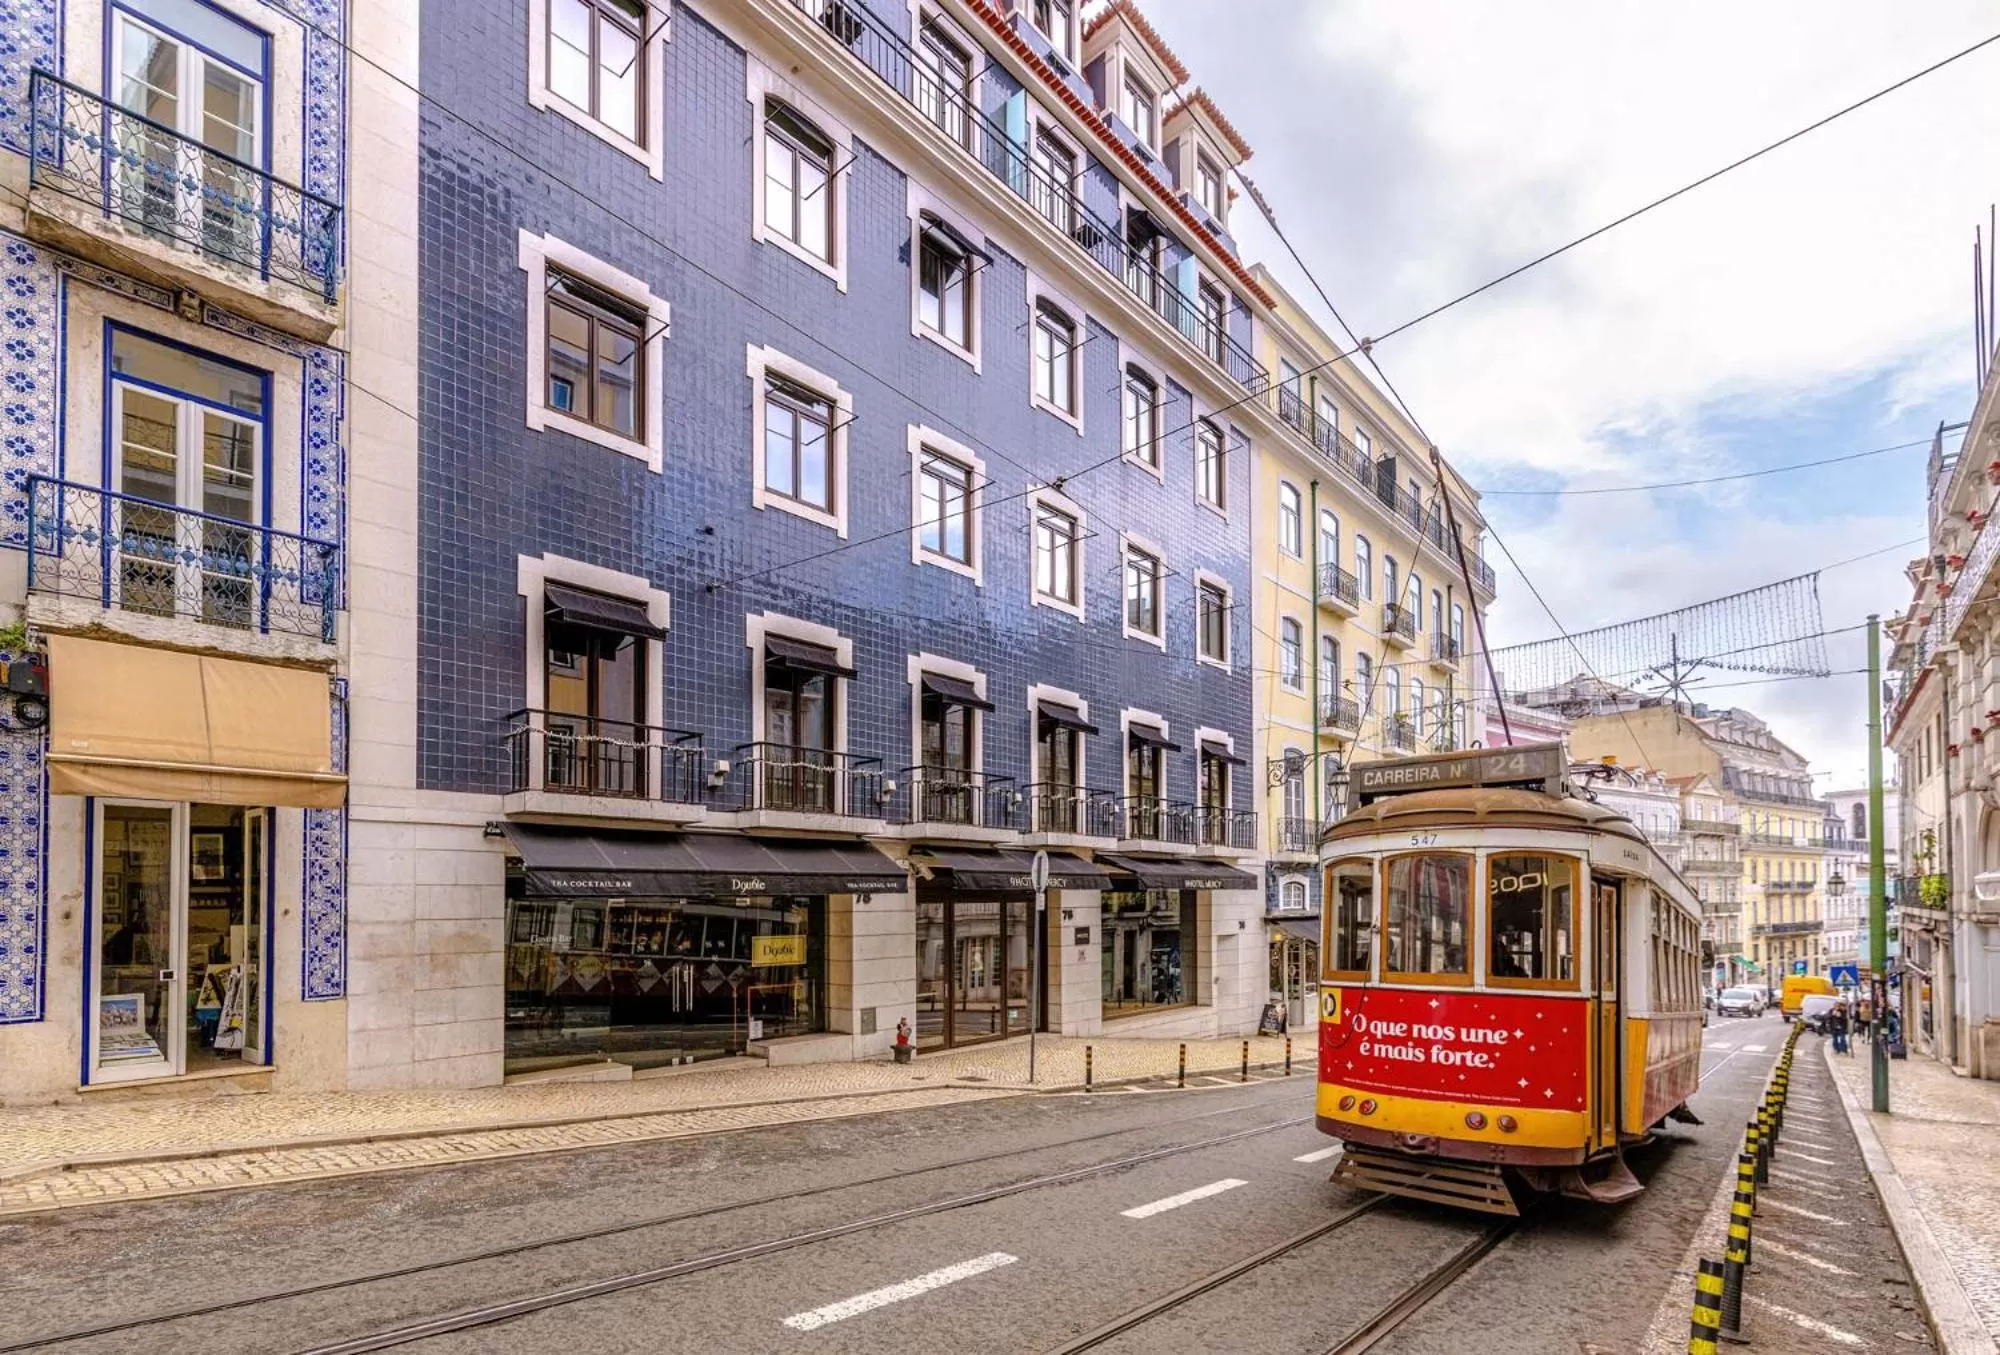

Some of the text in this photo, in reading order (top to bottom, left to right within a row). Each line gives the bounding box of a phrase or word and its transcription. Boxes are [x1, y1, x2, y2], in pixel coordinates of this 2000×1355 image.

[1363, 766, 1441, 786] CARREIRA
[1490, 752, 1527, 775] 24
[1411, 834, 1438, 846] 547
[569, 880, 614, 888] COCKTAIL
[615, 880, 632, 888] BAR
[1352, 1013, 1508, 1045] O que nos une
[1359, 1036, 1495, 1069] é mais forte.
